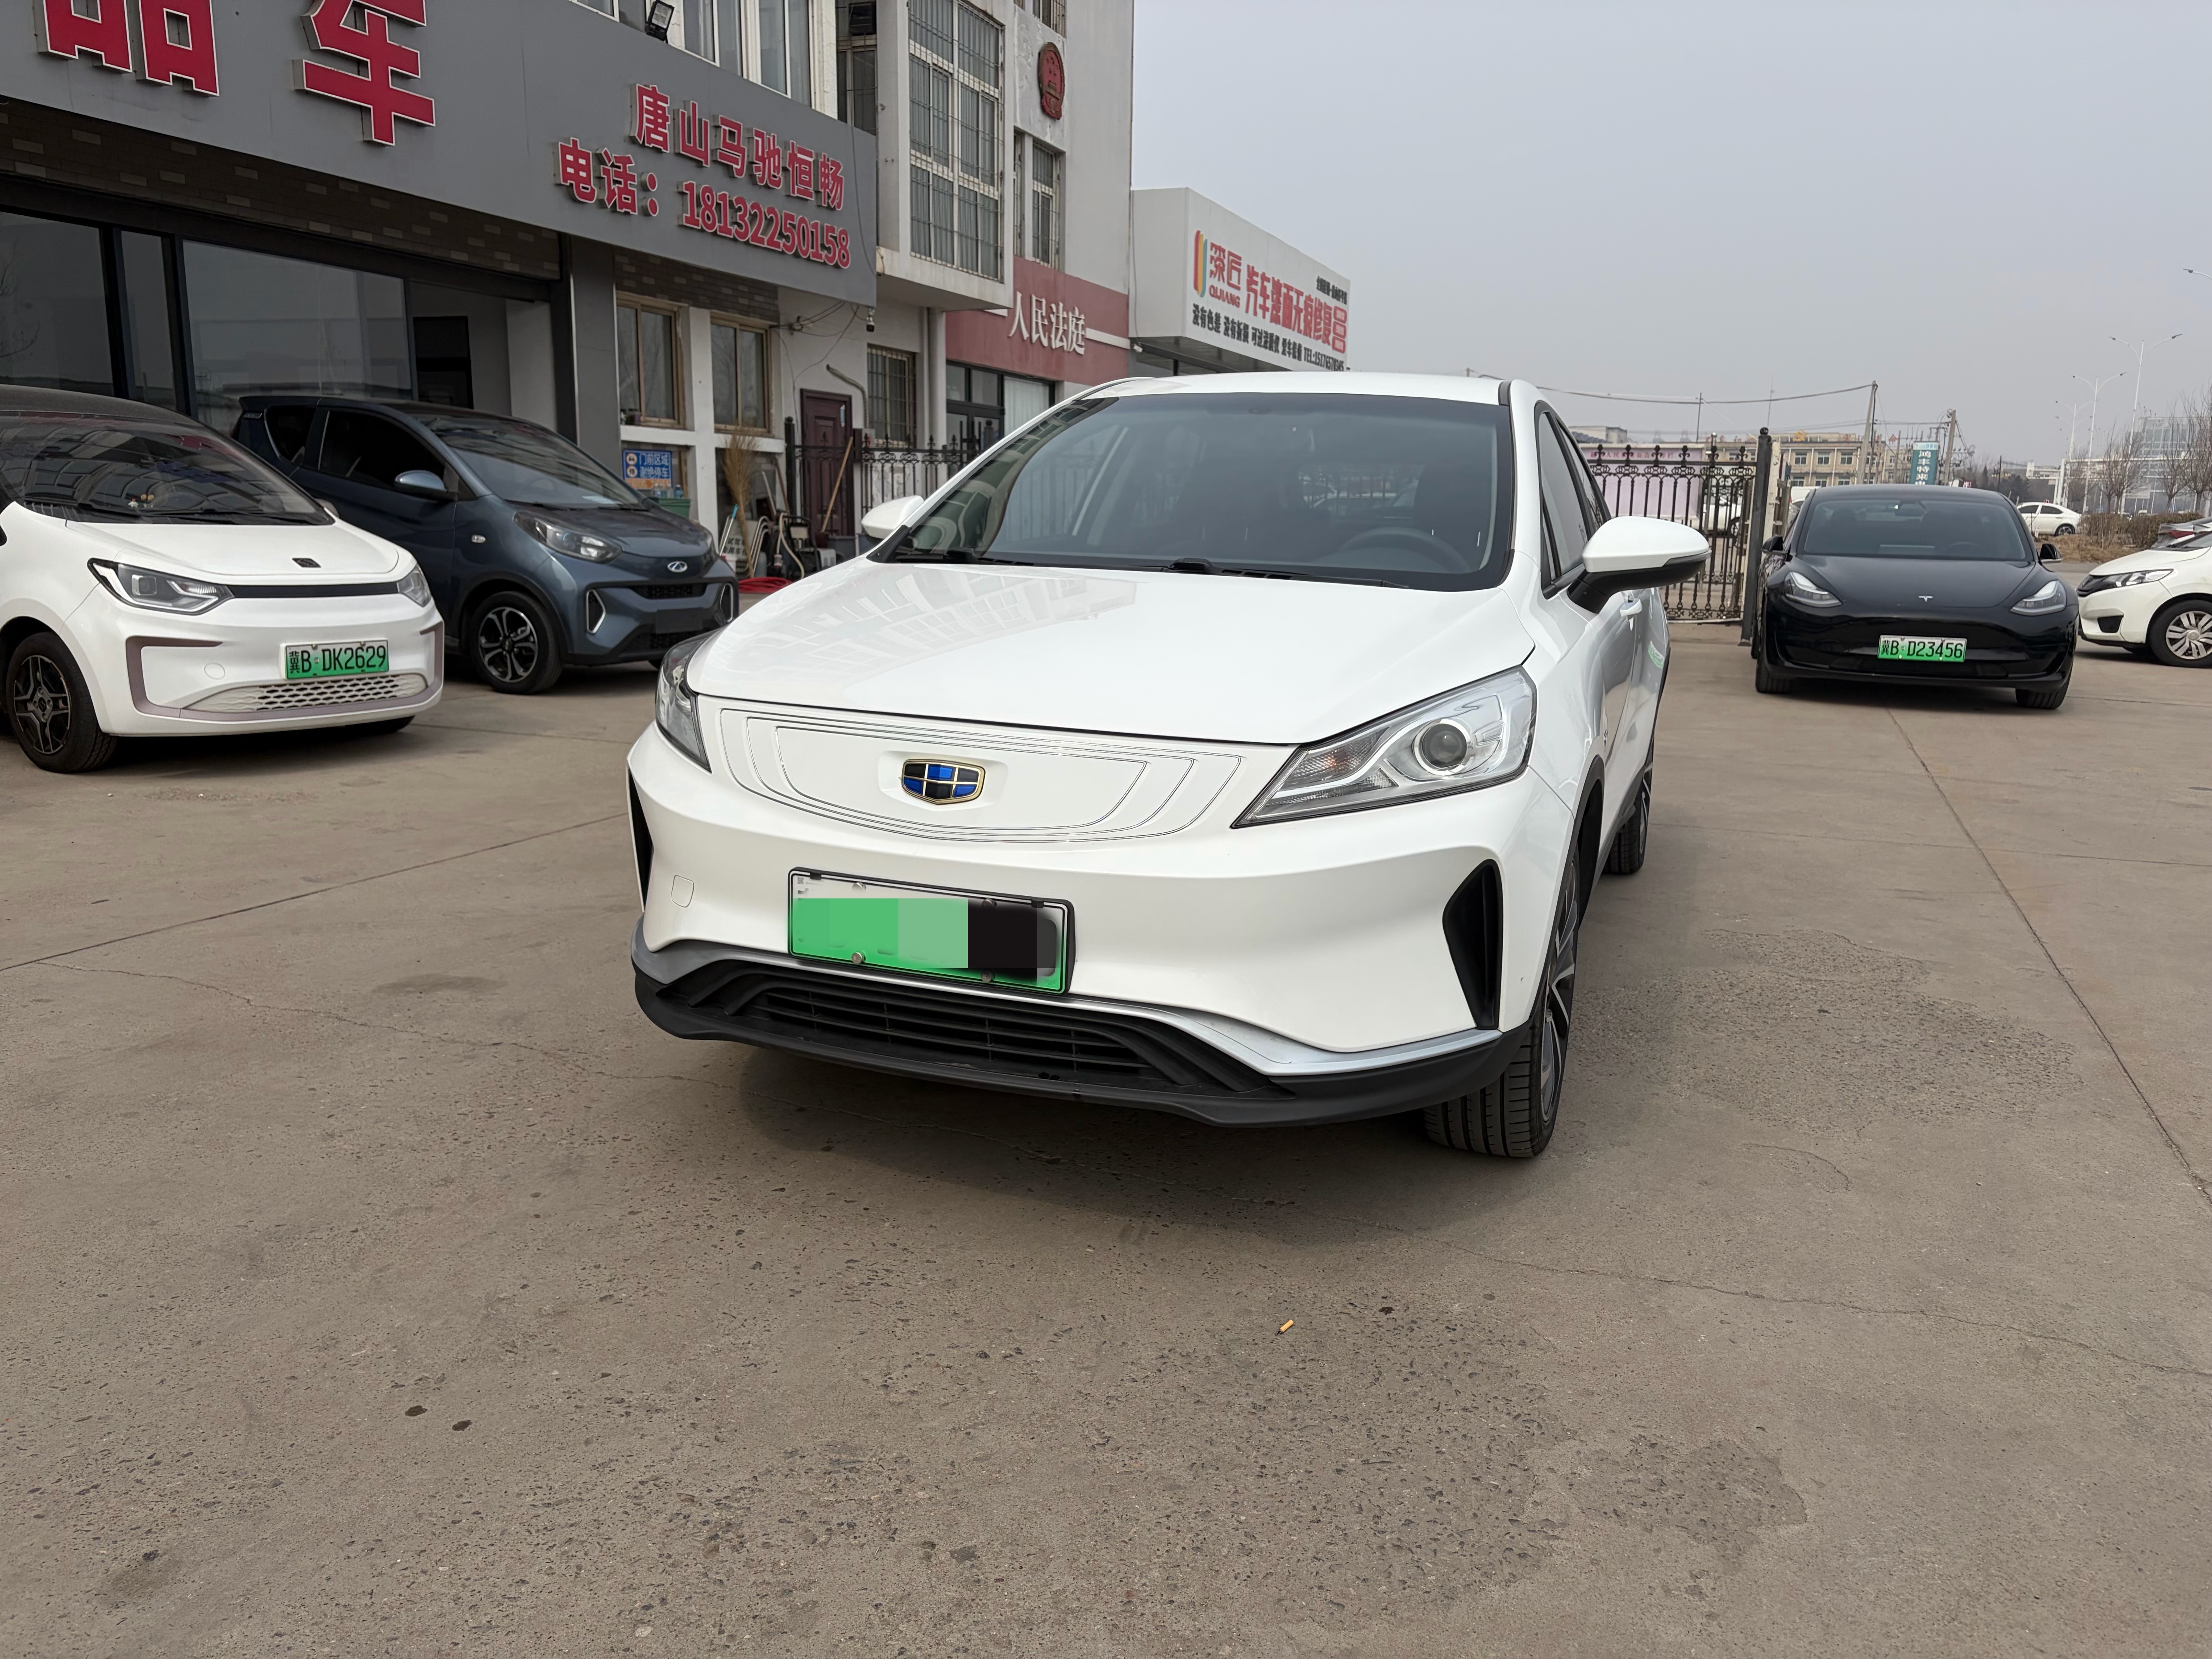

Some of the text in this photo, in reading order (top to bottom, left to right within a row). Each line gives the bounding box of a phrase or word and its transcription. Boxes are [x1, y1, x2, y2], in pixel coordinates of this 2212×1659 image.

[633, 83, 845, 210] 唐山马驰恒畅
[682, 180, 851, 269] 18132250158
[1008, 291, 1086, 355] 人民法庭
[639, 453, 669, 466] 门前区域
